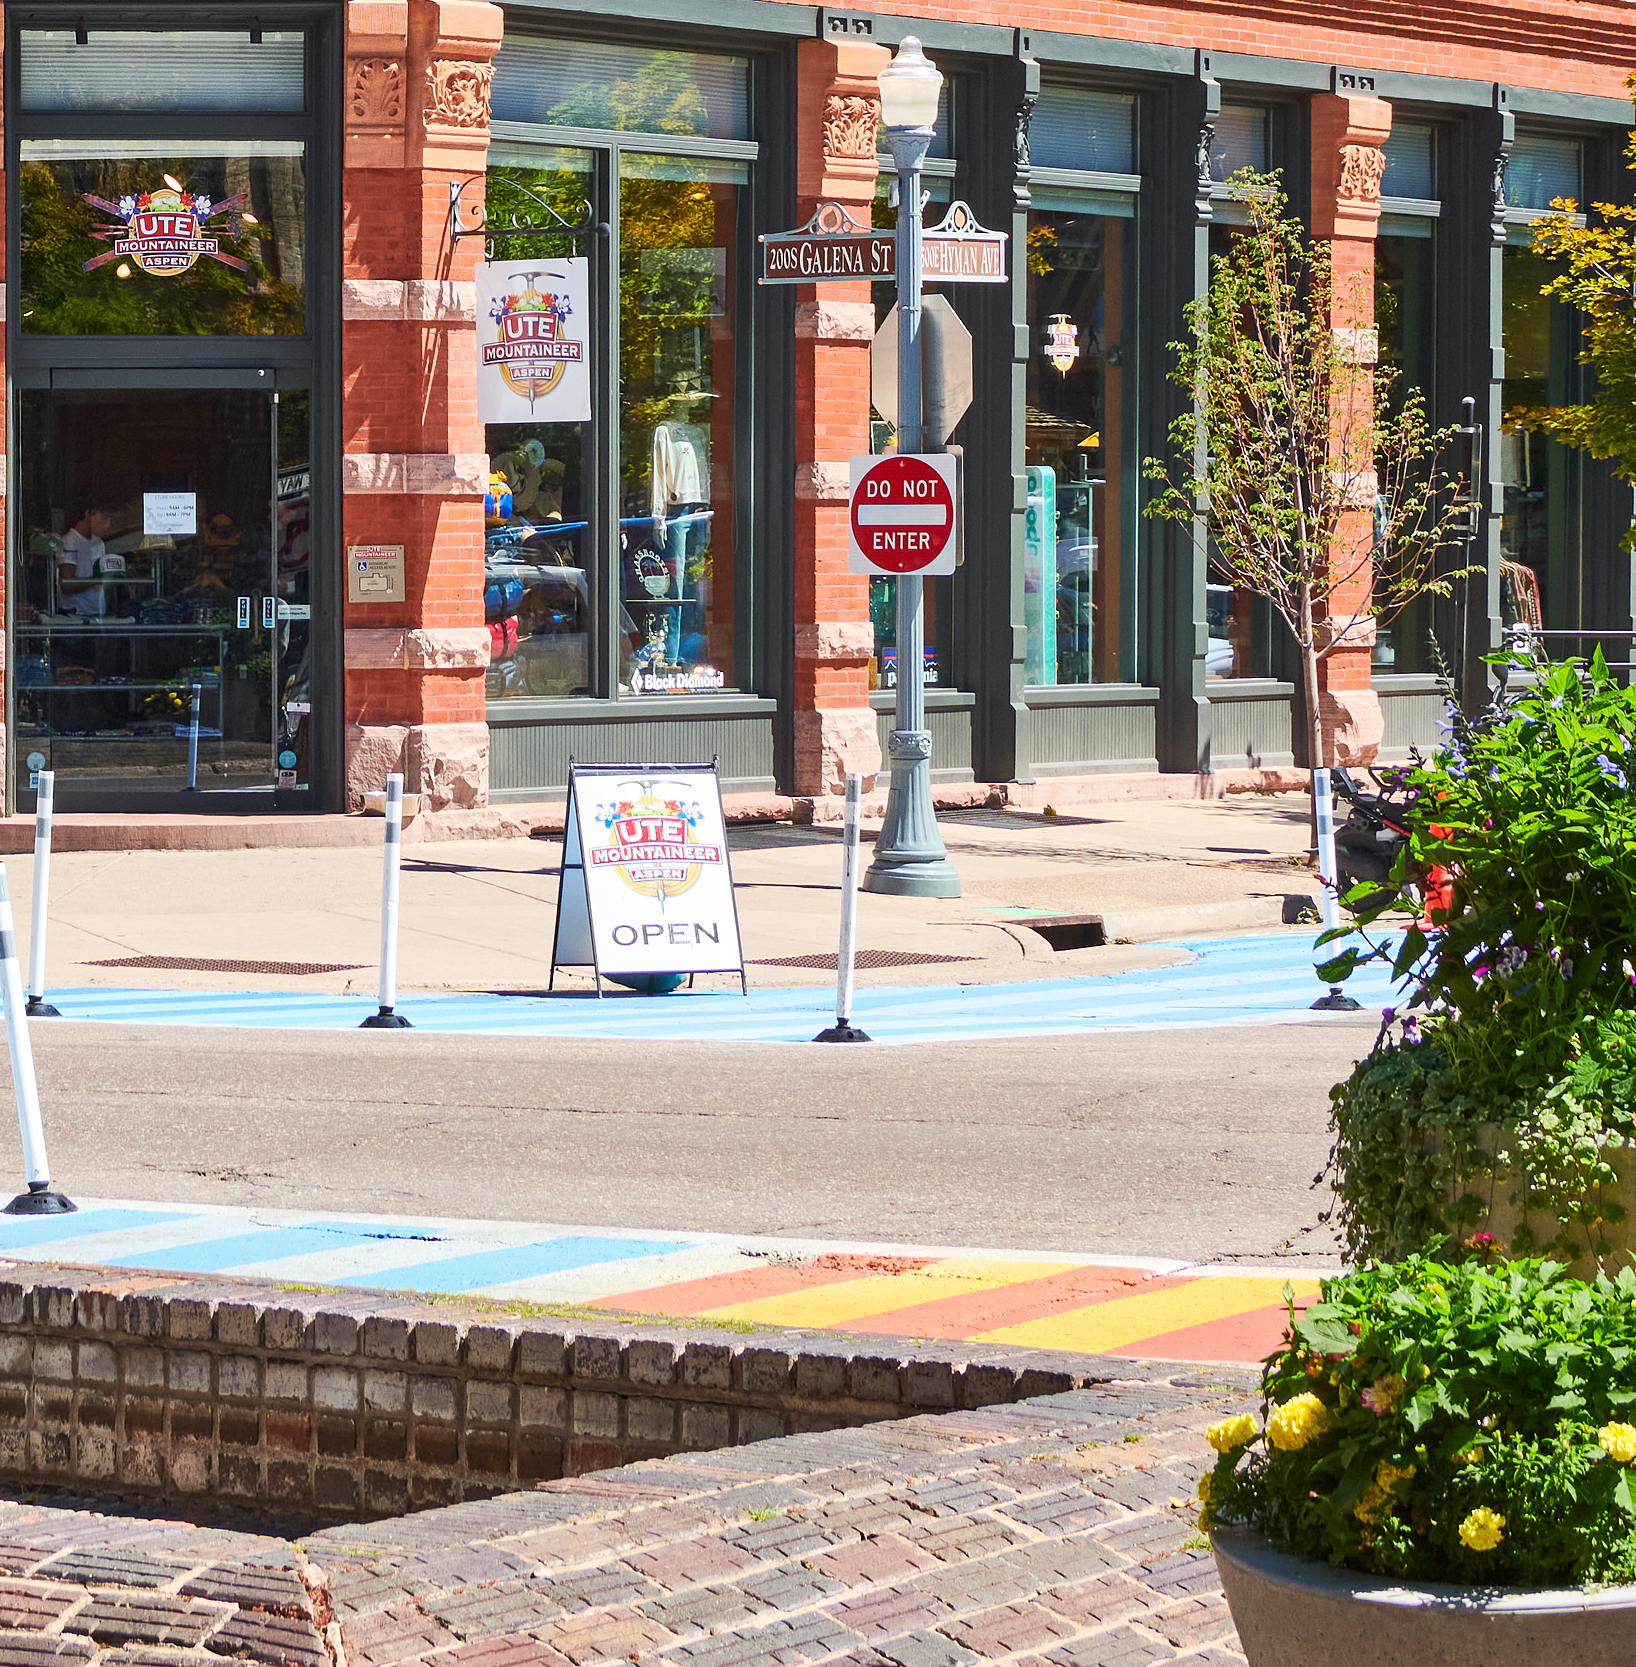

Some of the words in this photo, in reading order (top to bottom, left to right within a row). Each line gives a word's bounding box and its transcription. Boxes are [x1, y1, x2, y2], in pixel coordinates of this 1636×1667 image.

[139, 216, 192, 236] UTE
[119, 241, 215, 252] MOUNTAINEER
[145, 257, 188, 266] ASPEN
[769, 248, 798, 270] 200S
[799, 241, 865, 275] GALENA
[940, 241, 977, 274] HYMAN
[506, 315, 555, 341] UTE
[1055, 335, 1071, 345] UTE
[485, 344, 579, 360] MOUNTAINEER
[513, 367, 550, 378] ASPEN
[866, 479, 891, 498] DO
[903, 479, 938, 498] NOT
[873, 531, 931, 551] ENTER
[644, 673, 675, 690] Black
[676, 670, 724, 688] Diamond
[617, 819, 683, 843] UTE
[594, 847, 717, 864] MOUNTAINEER
[633, 870, 682, 879] ASPEN
[611, 923, 720, 946] OPEN
